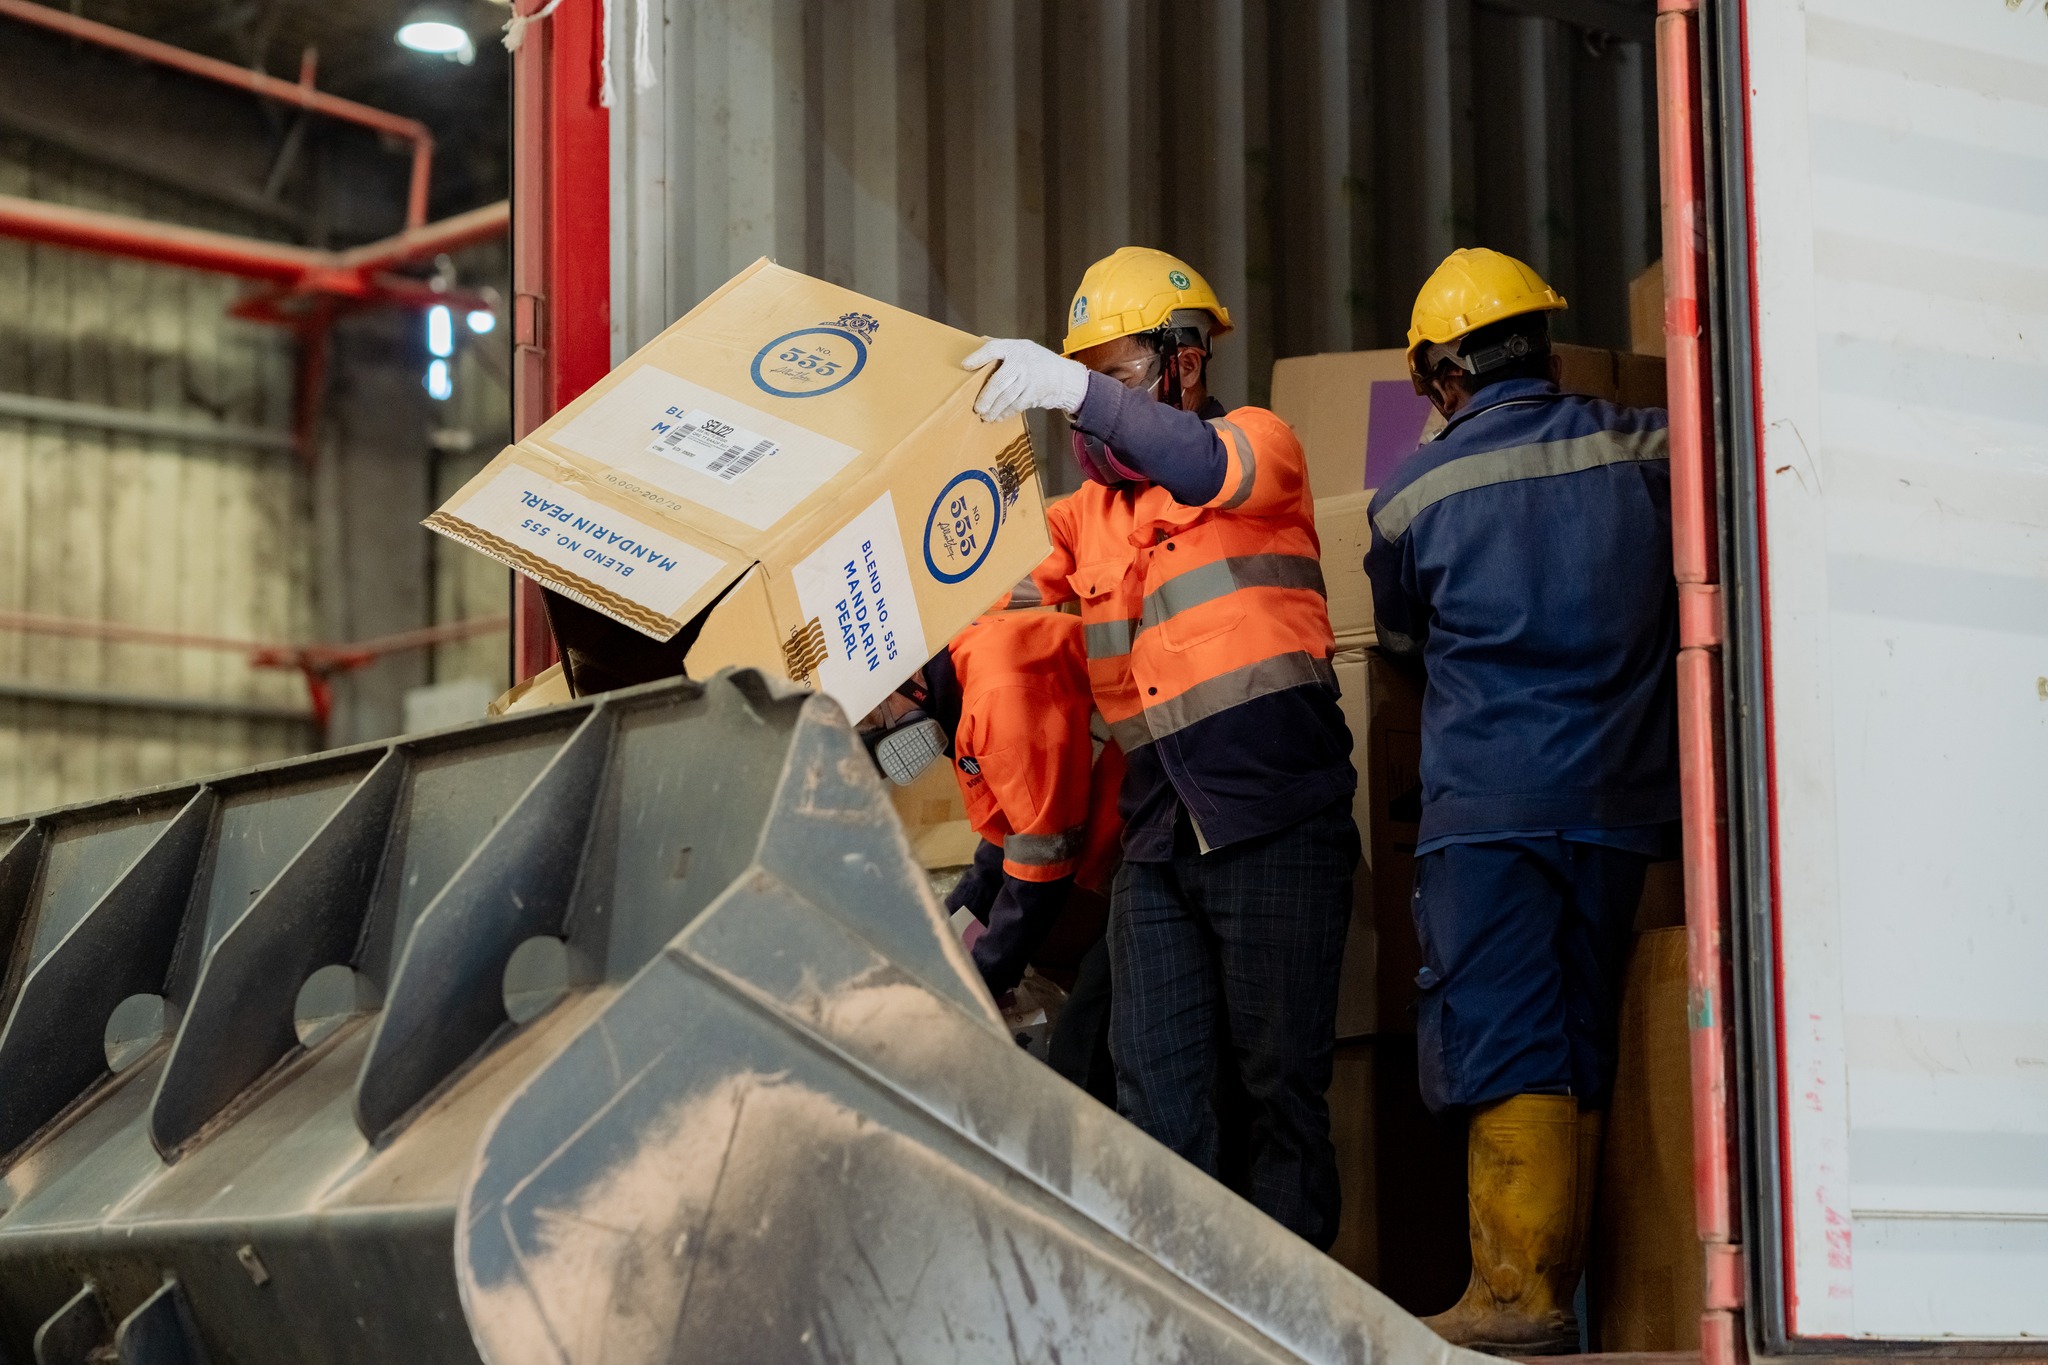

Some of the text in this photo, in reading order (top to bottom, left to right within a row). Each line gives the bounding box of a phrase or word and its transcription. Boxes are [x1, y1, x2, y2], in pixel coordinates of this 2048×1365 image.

[780, 347, 842, 376] 555
[815, 346, 832, 356] NO.
[604, 474, 682, 511] 10,000-200/20
[972, 505, 980, 525] NO.
[520, 490, 678, 572] MANDARIN PEARL
[521, 519, 635, 577] BLEND NO. 555
[951, 496, 976, 556] 555
[835, 598, 858, 661] PEARL
[844, 560, 880, 672] MANDARIN
[861, 540, 898, 661] BLEND NO. 555
[912, 690, 927, 701] 3M
